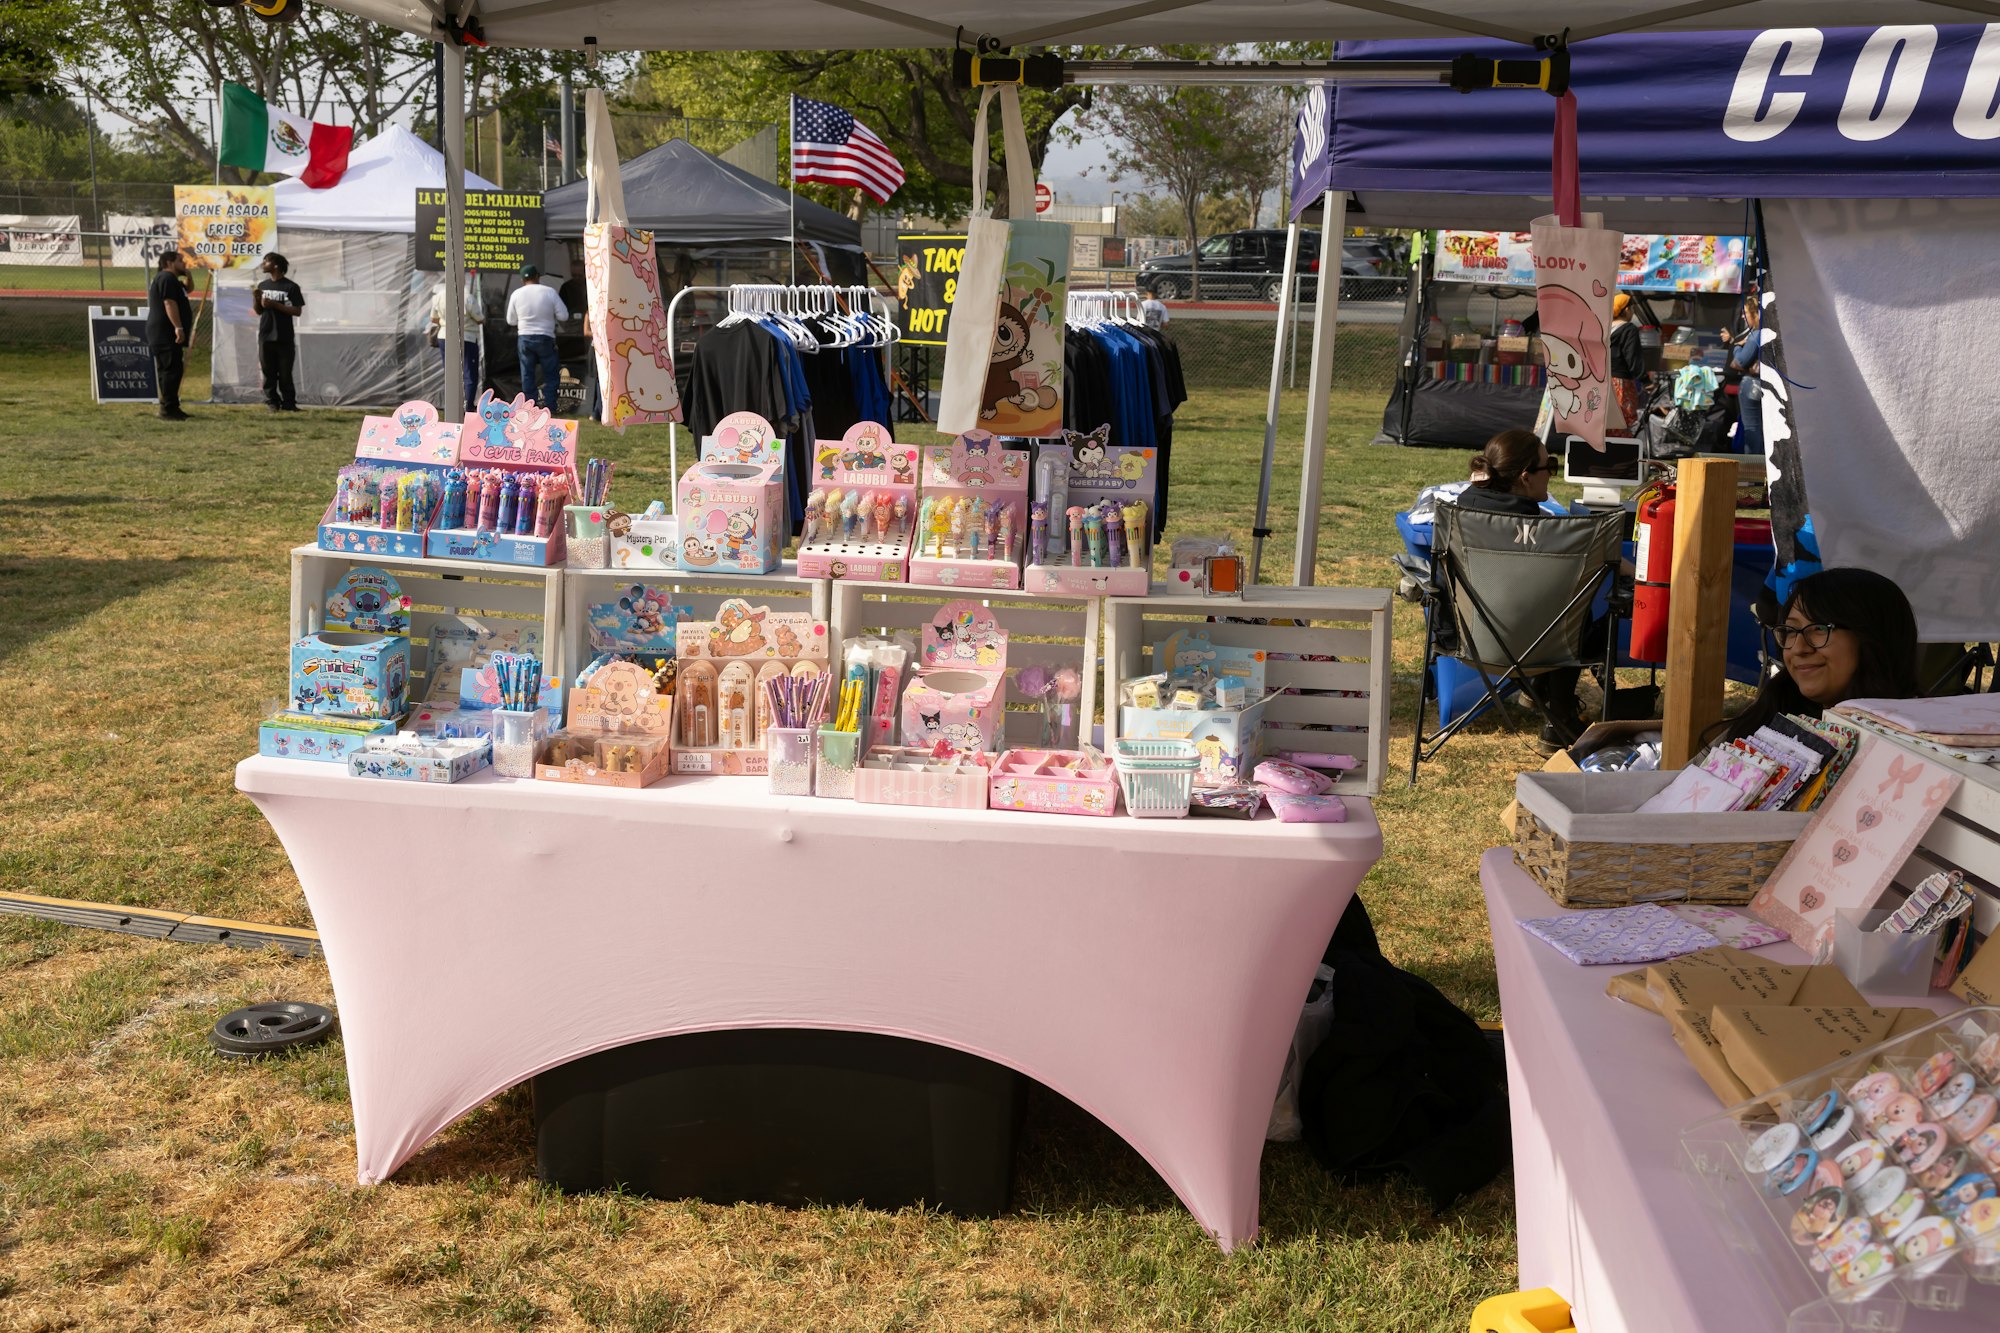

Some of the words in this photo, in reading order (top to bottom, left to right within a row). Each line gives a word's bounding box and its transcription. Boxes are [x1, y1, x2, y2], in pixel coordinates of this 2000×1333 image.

[418, 192, 432, 205] LA
[465, 194, 484, 206] DEL
[486, 194, 541, 208] MARIACHI
[182, 204, 221, 216] CARNE
[226, 205, 269, 216] ASADA
[207, 223, 245, 236] FRIES
[17, 243, 71, 251] SERVICES
[195, 243, 226, 254] SOLD
[231, 243, 263, 255] HERE
[478, 261, 511, 269] MONSTERS
[923, 248, 965, 273] TACO
[1462, 255, 1480, 269] HOT
[1481, 256, 1508, 269] DOGS
[1533, 255, 1576, 271] ELODY
[909, 308, 948, 333] HOT
[99, 345, 150, 357] MARIACHI
[107, 380, 149, 389] SERVICES
[484, 445, 522, 460] CUTE
[526, 448, 569, 465] FAIRY
[1021, 452, 1028, 460] 3
[843, 473, 888, 486] LABUBU
[1069, 478, 1096, 487] SWEET
[709, 494, 757, 504] LABUBU
[626, 535, 653, 544] Mystery
[654, 535, 667, 544] Pen
[850, 564, 877, 573] LABUBU
[302, 657, 365, 677] Stitch
[1860, 810, 1876, 827] $18
[1835, 846, 1852, 862] $23
[1802, 892, 1818, 909] $23
[1754, 966, 1779, 991] Mystery
